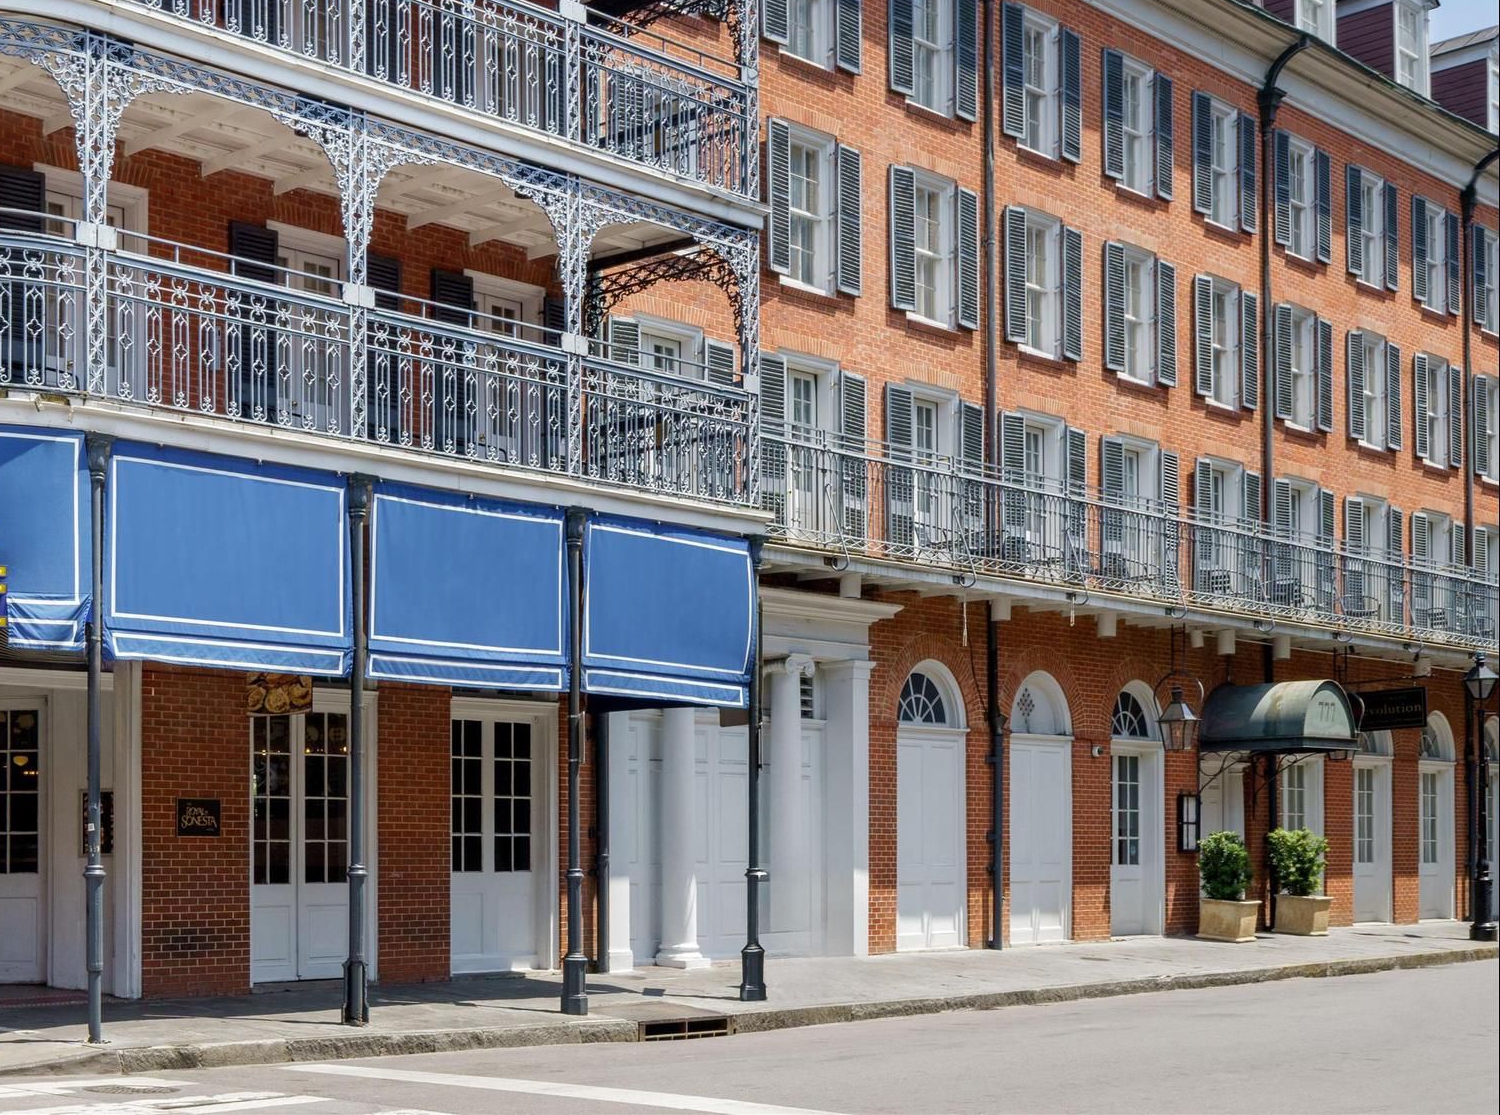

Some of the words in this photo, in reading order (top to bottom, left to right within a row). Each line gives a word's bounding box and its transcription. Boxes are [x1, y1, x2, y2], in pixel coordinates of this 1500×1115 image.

[1318, 701, 1336, 723] 777
[186, 806, 205, 816] ROYAL
[181, 815, 218, 829] SONESTA
